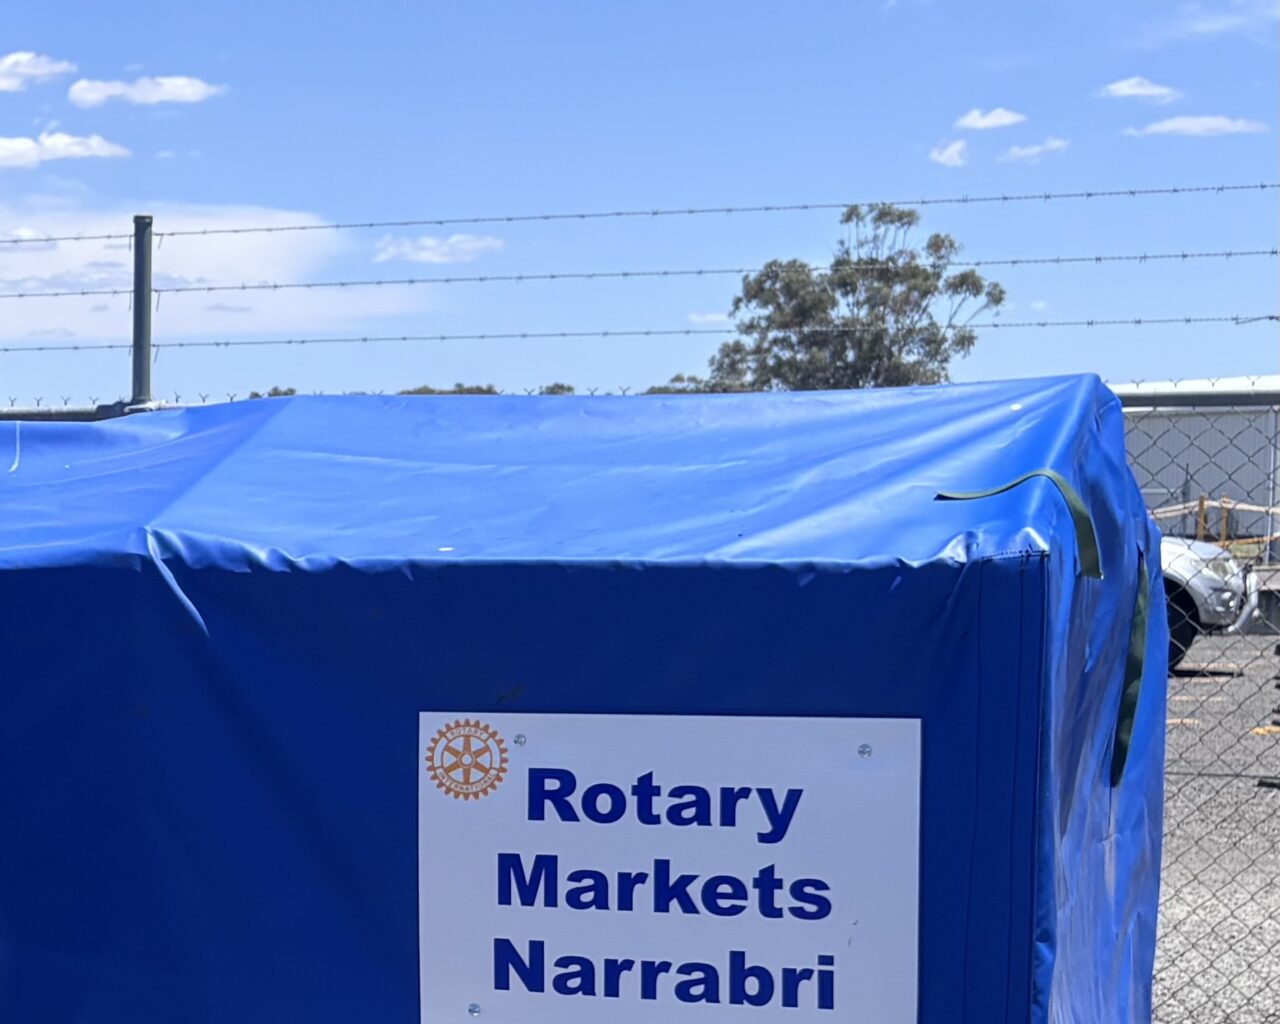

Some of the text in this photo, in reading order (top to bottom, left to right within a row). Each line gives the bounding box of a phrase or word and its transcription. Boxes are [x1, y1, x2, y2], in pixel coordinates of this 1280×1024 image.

[449, 727, 485, 737] ROTARY
[528, 768, 803, 844] Rotary
[498, 853, 831, 920] Markets
[494, 938, 834, 1010] Narrabri
